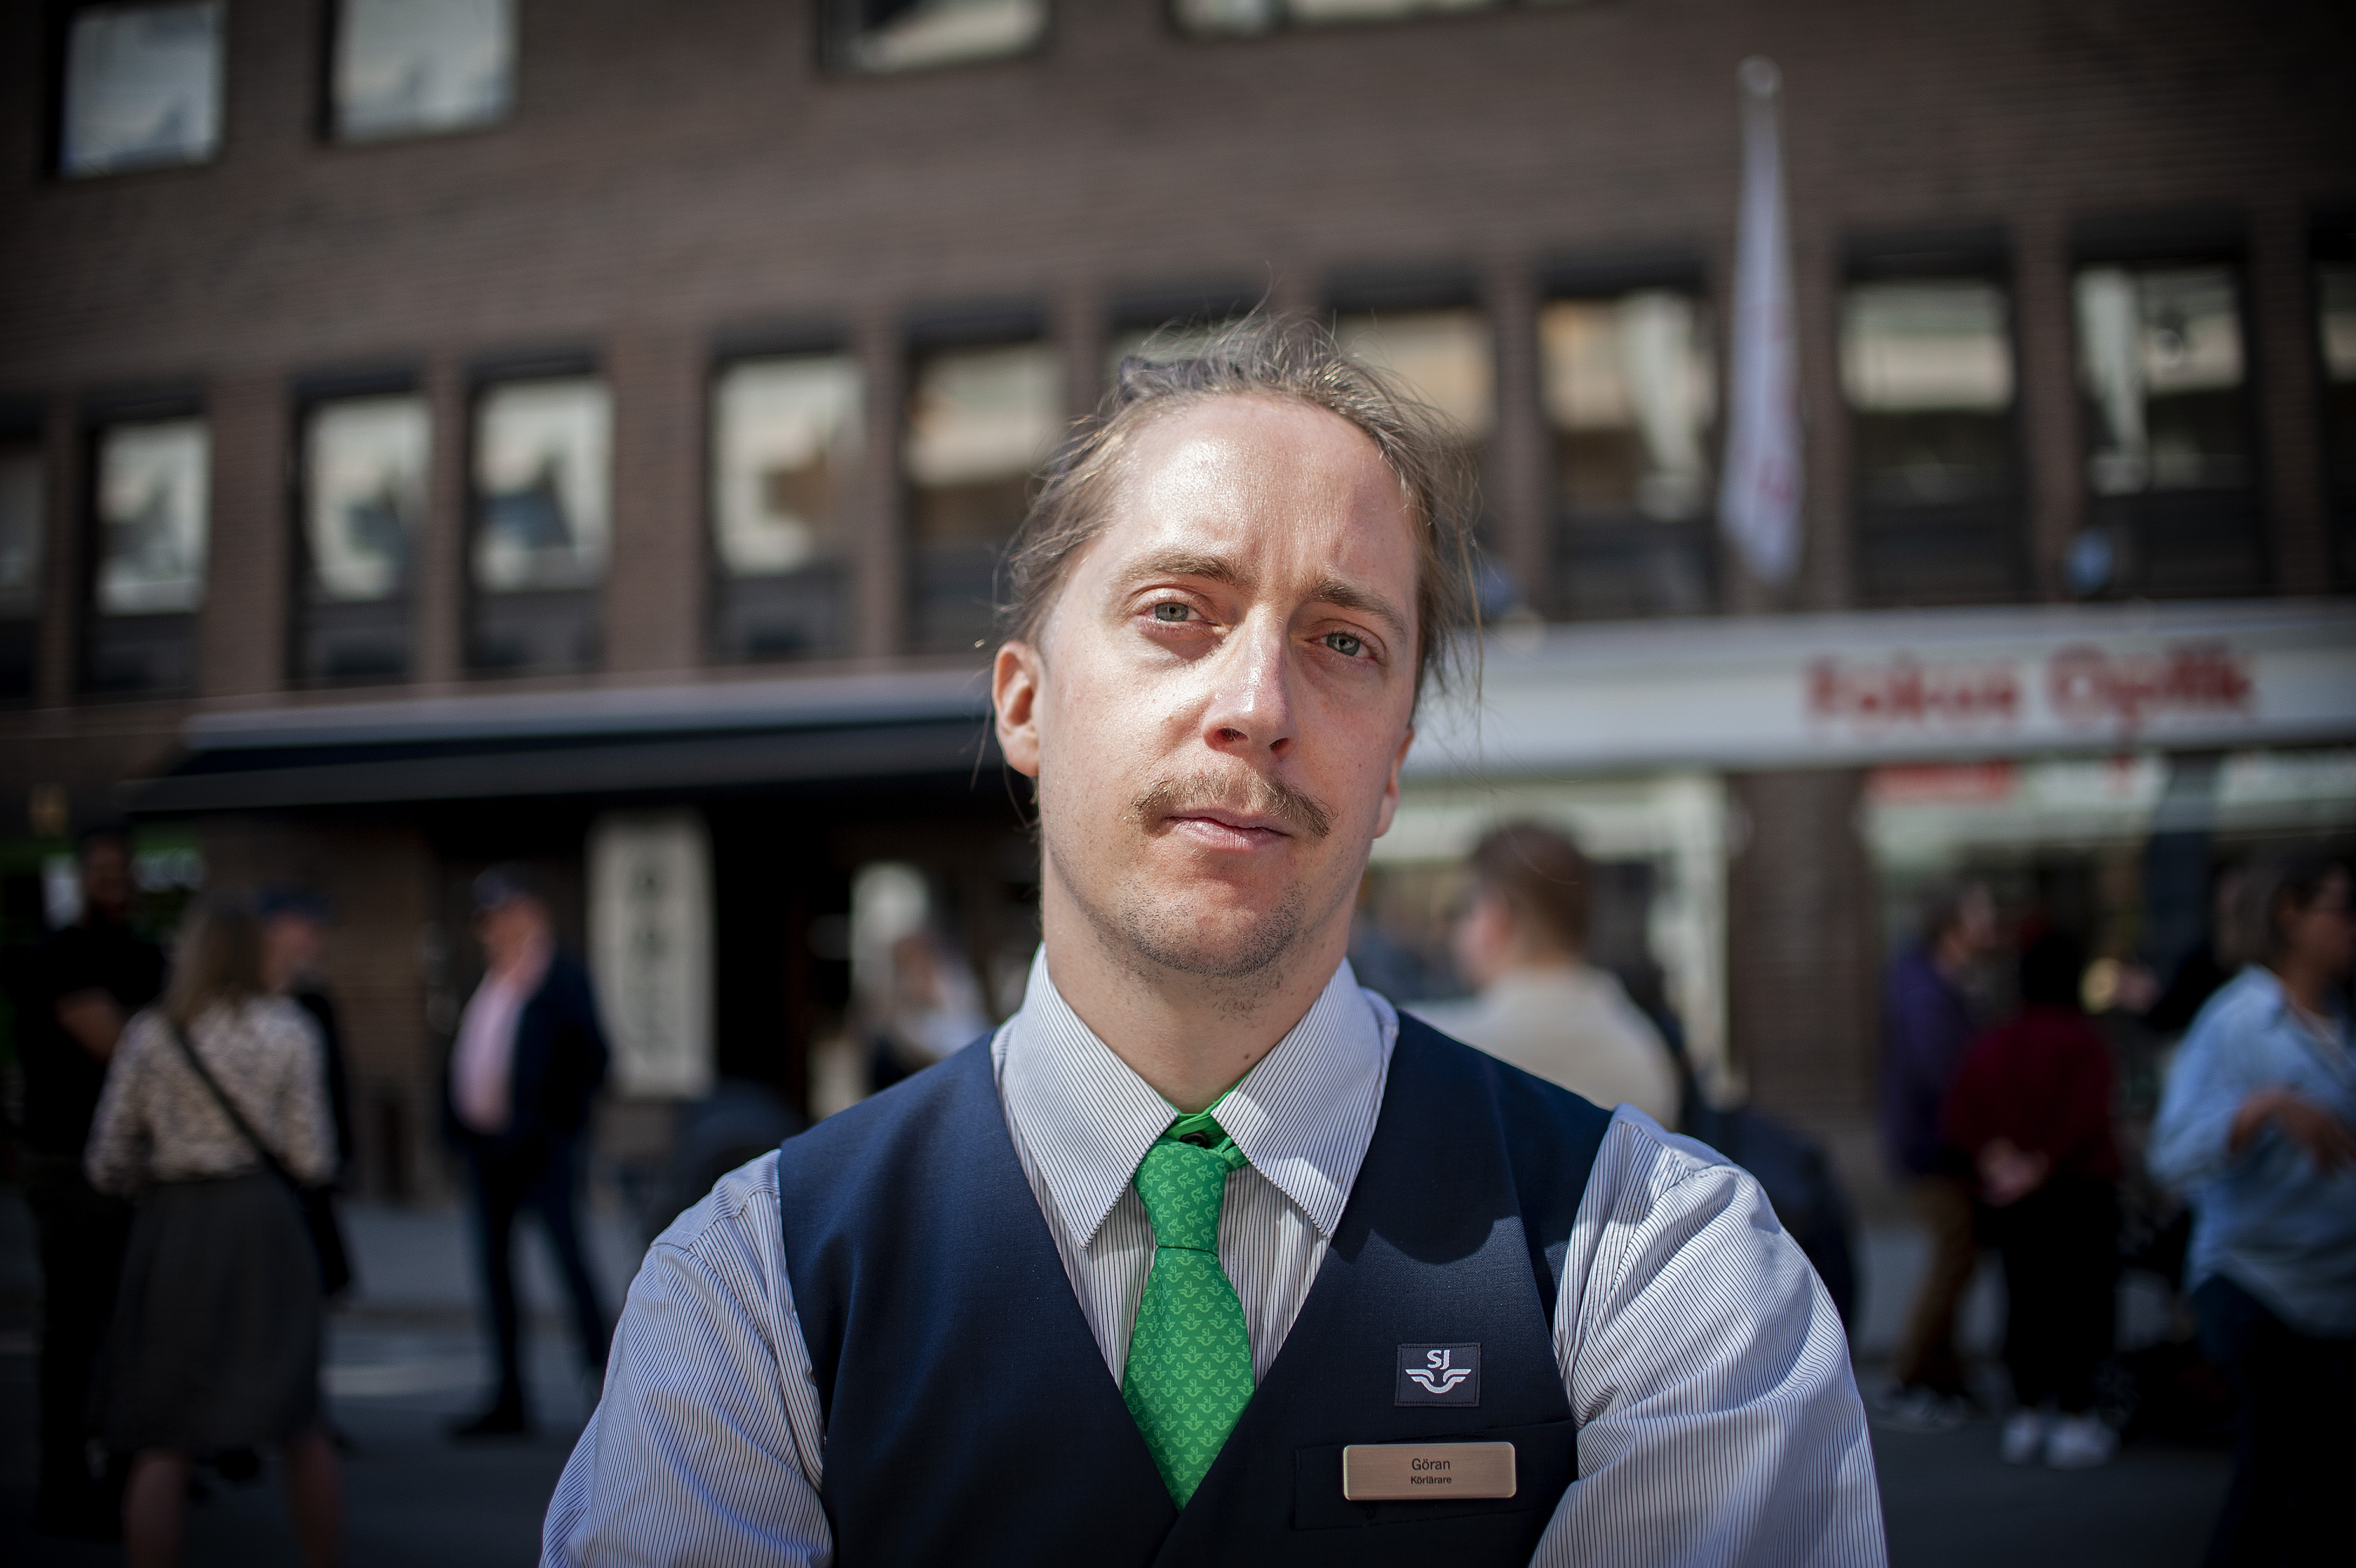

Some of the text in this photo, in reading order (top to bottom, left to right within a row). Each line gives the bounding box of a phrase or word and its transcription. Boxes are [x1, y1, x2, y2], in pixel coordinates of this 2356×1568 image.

[1427, 1350, 1450, 1370] SJ
[1412, 1458, 1450, 1471] Göran
[1411, 1476, 1452, 1485] Körlärare
